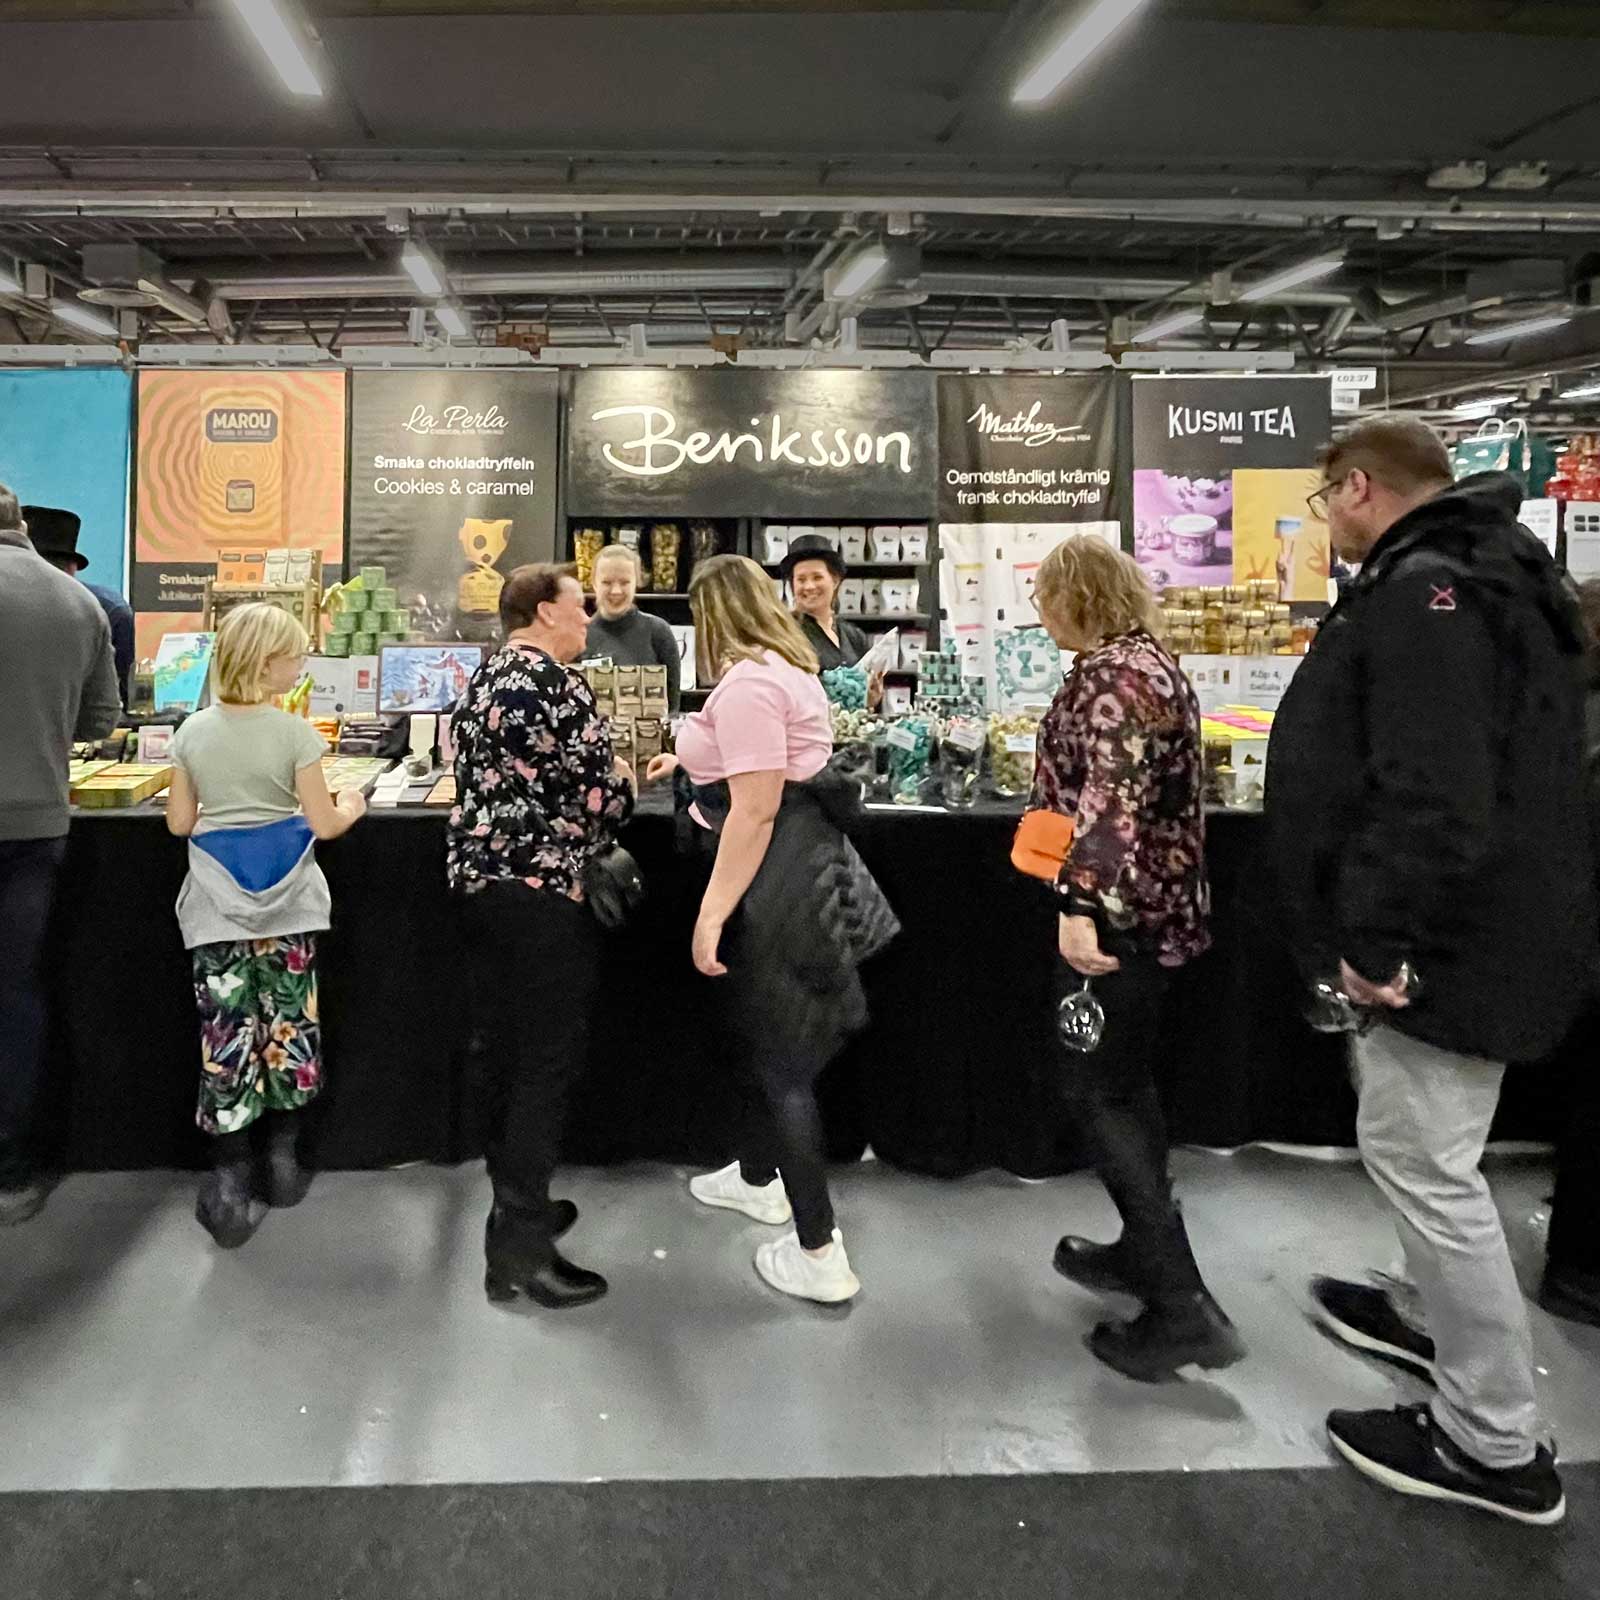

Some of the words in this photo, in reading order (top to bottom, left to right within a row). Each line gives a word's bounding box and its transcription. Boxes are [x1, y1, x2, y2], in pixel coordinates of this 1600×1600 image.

[212, 411, 272, 429] MAROU
[401, 404, 439, 435] La
[443, 404, 509, 429] Perla
[966, 400, 1083, 447] Mathez
[1168, 403, 1243, 439] KUSMI
[1250, 405, 1296, 438] TEA
[374, 455, 425, 469] Smaka
[428, 456, 535, 472] chokladtryffeln
[374, 477, 445, 495] Cookies
[449, 478, 462, 495] &
[466, 479, 534, 496] caramel
[946, 468, 1056, 487] Oemotståndligt
[1060, 468, 1110, 486] krämig
[957, 489, 1000, 505] fransk
[1002, 488, 1101, 508] chokladtryffel
